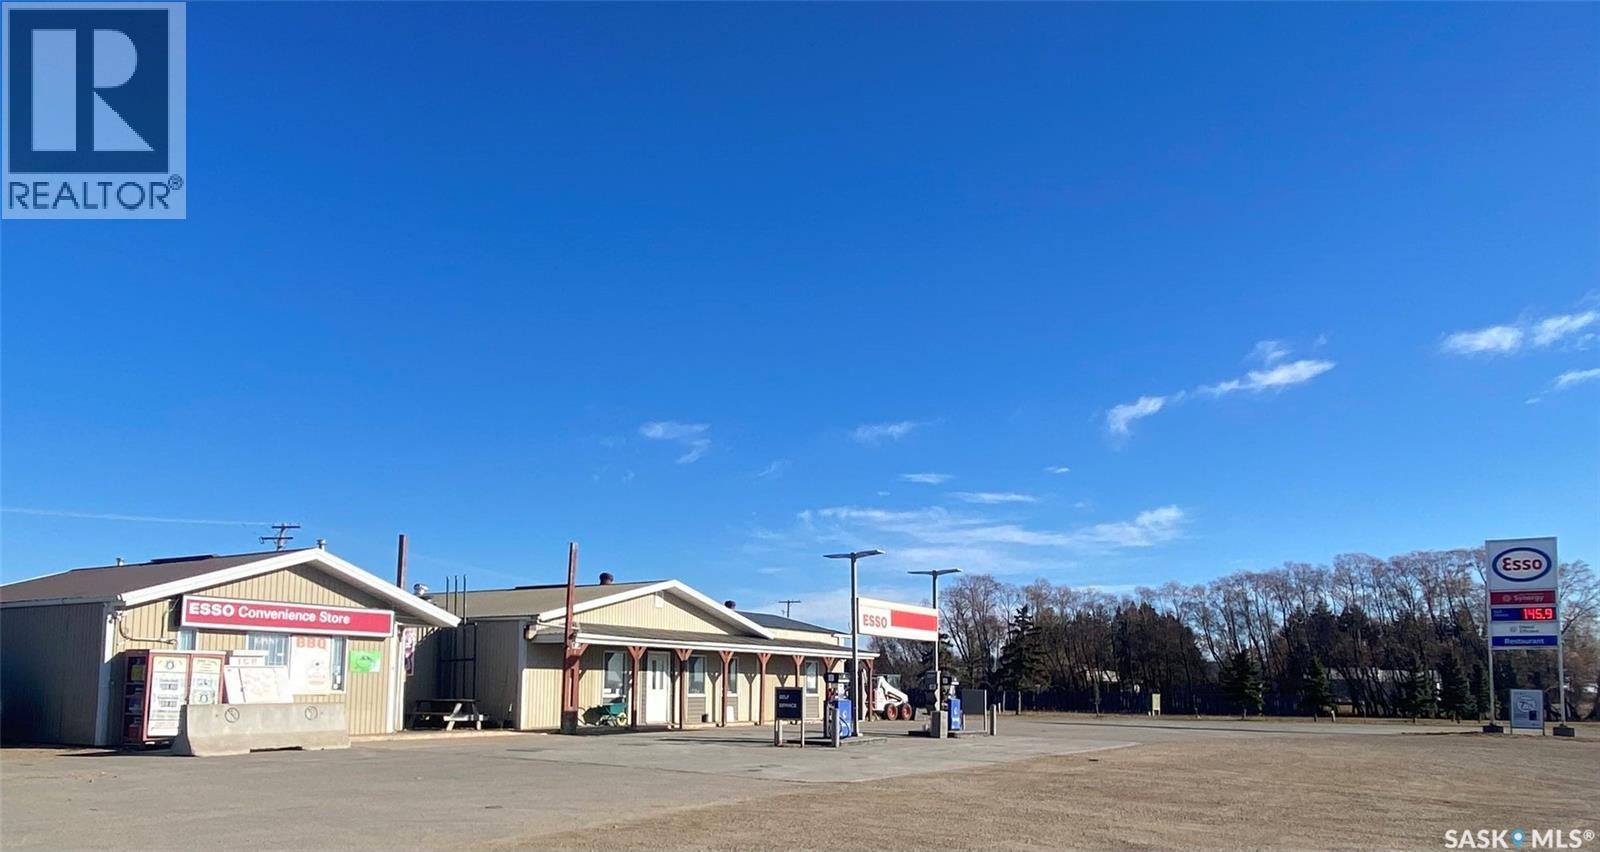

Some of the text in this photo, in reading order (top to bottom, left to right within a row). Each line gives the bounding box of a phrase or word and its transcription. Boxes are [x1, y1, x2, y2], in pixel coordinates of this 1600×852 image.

[1513, 594, 1544, 602] Synergy
[189, 602, 351, 625] ESSO Convenience Store
[1523, 608, 1553, 620] 145.9
[863, 614, 888, 629] ESSO
[296, 636, 327, 649] BBQ
